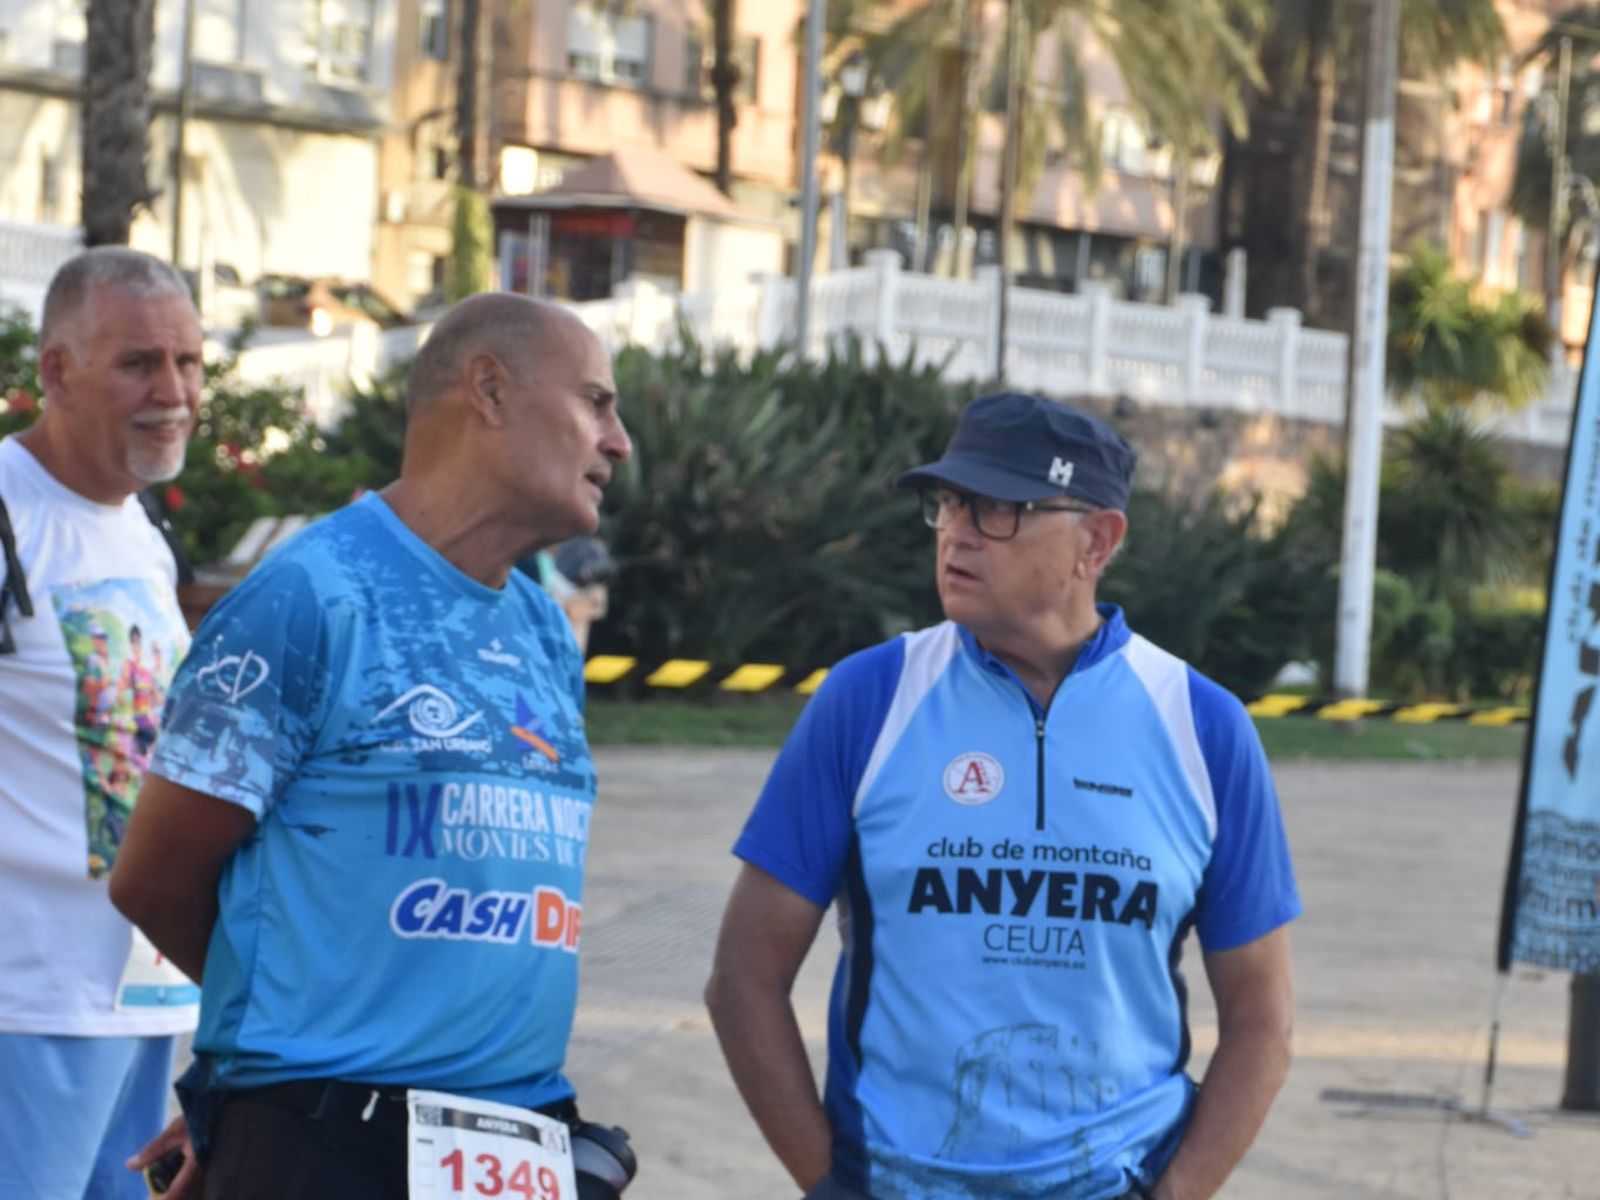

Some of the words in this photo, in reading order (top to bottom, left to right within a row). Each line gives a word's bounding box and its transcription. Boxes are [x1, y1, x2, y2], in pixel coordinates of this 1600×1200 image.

[953, 760, 991, 794] A
[384, 782, 442, 859] IX
[441, 782, 550, 832] CARRERA
[927, 837, 983, 858] club
[992, 839, 1024, 859] de
[1033, 843, 1152, 871] montaña
[392, 879, 528, 940] CASH
[907, 867, 1158, 930] ANYERA
[984, 924, 1085, 956] CEUTA
